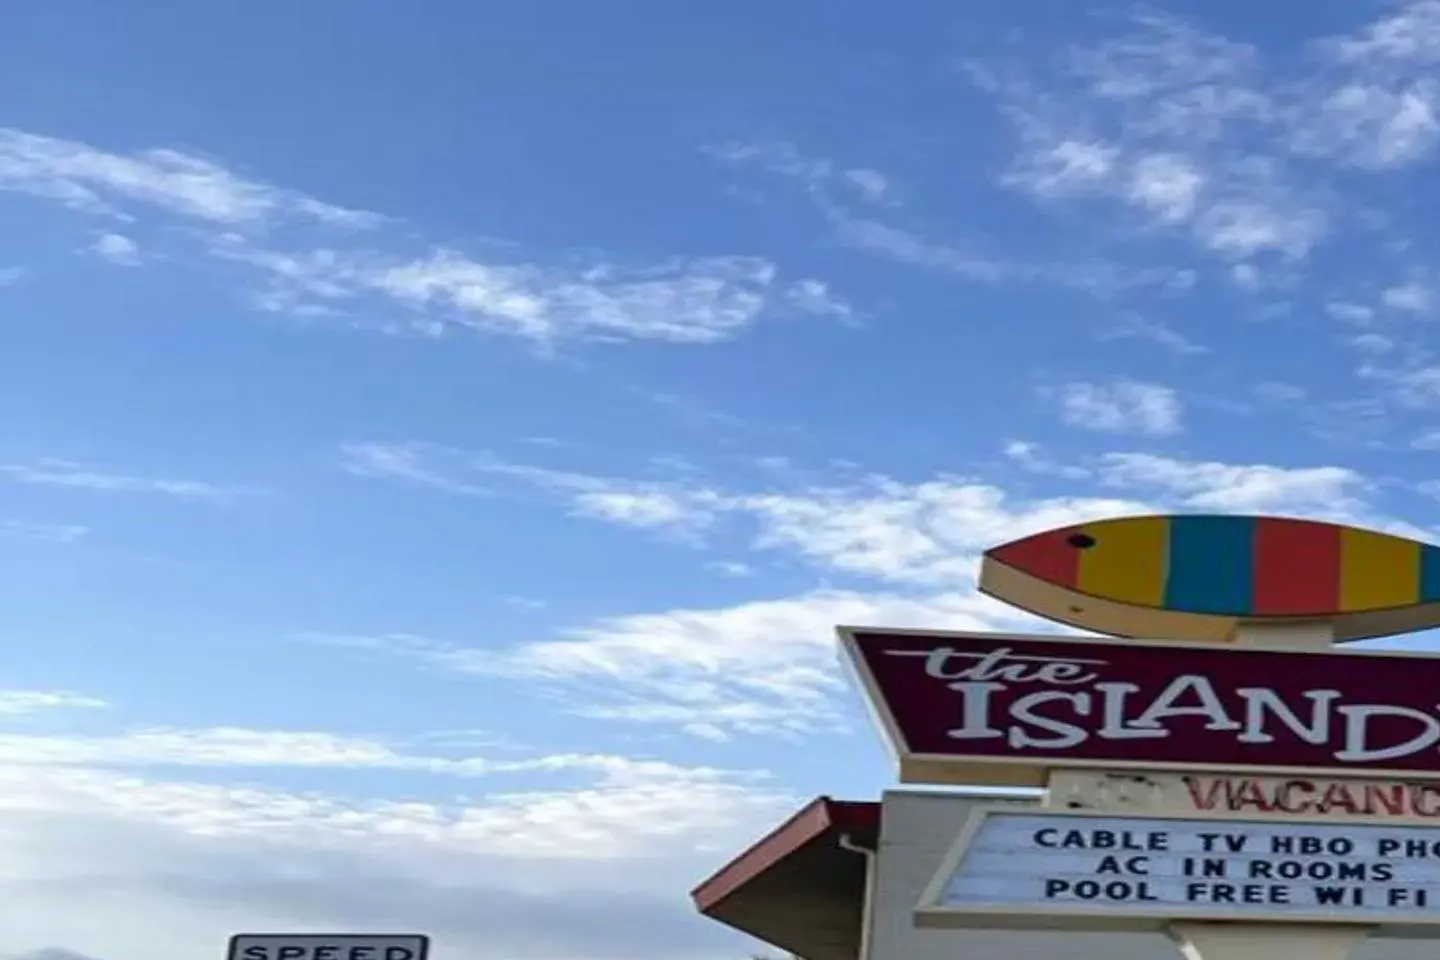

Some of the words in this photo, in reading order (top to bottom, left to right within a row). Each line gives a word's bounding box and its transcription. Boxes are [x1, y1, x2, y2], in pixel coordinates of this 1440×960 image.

[884, 648, 1110, 684] the
[1033, 828, 1169, 851] CABLE
[1198, 833, 1248, 853] TV
[1270, 836, 1354, 856] HBO
[1096, 855, 1150, 875] AC
[1182, 857, 1227, 877] IN
[1249, 859, 1394, 881] ROOMS
[1044, 879, 1158, 901] POOL
[1186, 883, 1291, 904] FREE
[1313, 886, 1364, 905] WI
[1387, 888, 1427, 907] FI
